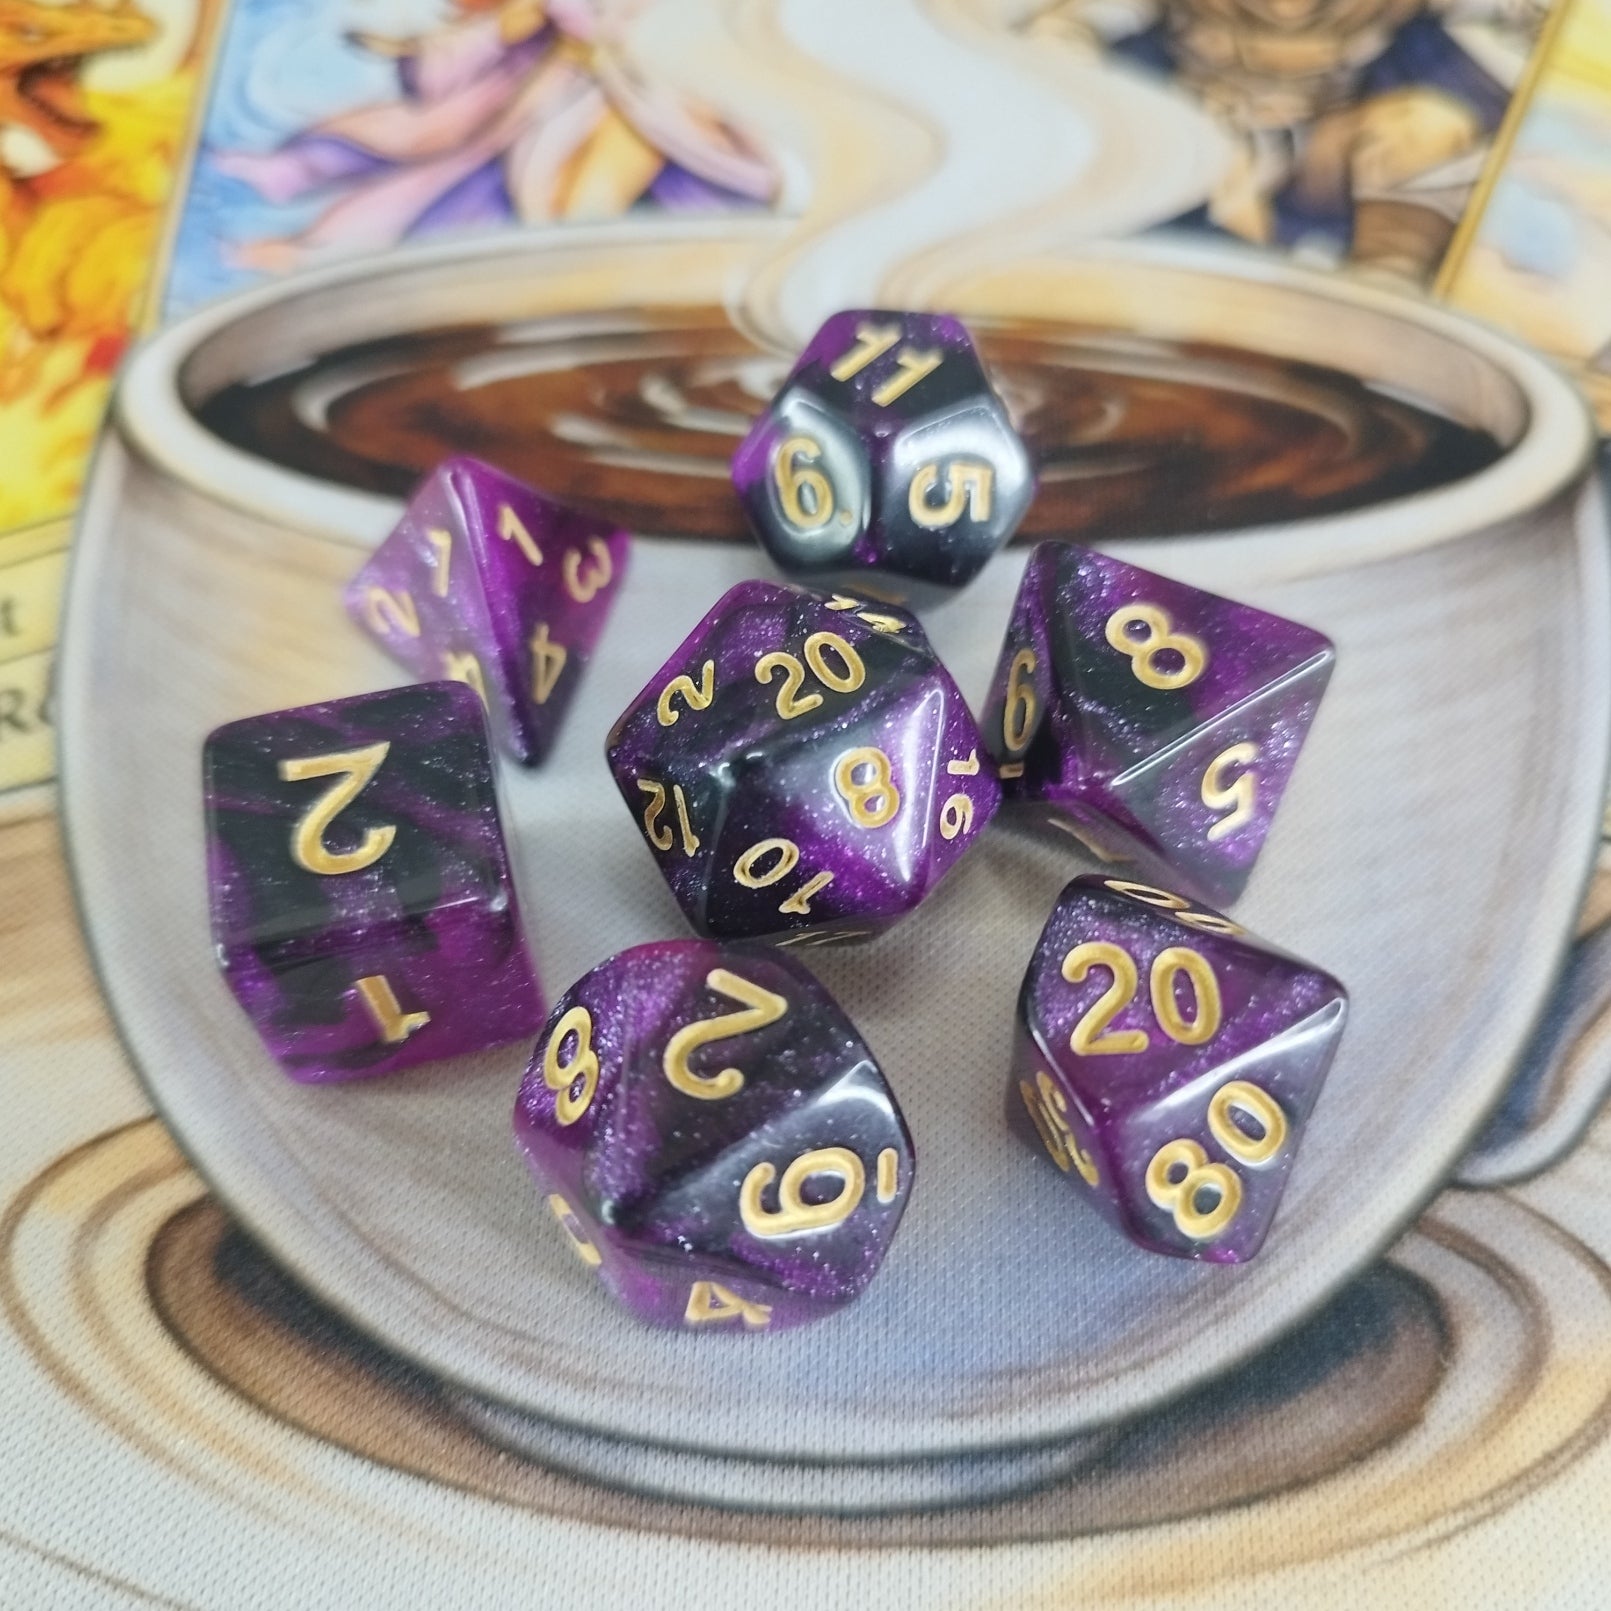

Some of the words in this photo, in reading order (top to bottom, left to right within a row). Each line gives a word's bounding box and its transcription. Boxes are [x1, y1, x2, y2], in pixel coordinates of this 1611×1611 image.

[831, 323, 943, 406] 11
[499, 503, 543, 566] 1
[908, 462, 994, 529] 5
[426, 529, 452, 598] 1
[562, 536, 613, 603] 3
[366, 587, 421, 638] 2
[1105, 604, 1207, 690] 8
[531, 622, 567, 705] 4
[657, 659, 715, 727] 2
[754, 631, 866, 719] 20
[278, 741, 397, 875] 2
[636, 778, 700, 857] 12
[833, 746, 900, 829] 8
[938, 748, 981, 840] 16
[1201, 742, 1258, 842] 5
[733, 837, 834, 914] 10
[356, 974, 432, 1043] 1
[663, 968, 788, 1099] 2
[1061, 941, 1222, 1056] 20
[544, 1006, 599, 1126] 8
[1145, 1080, 1288, 1240] 80
